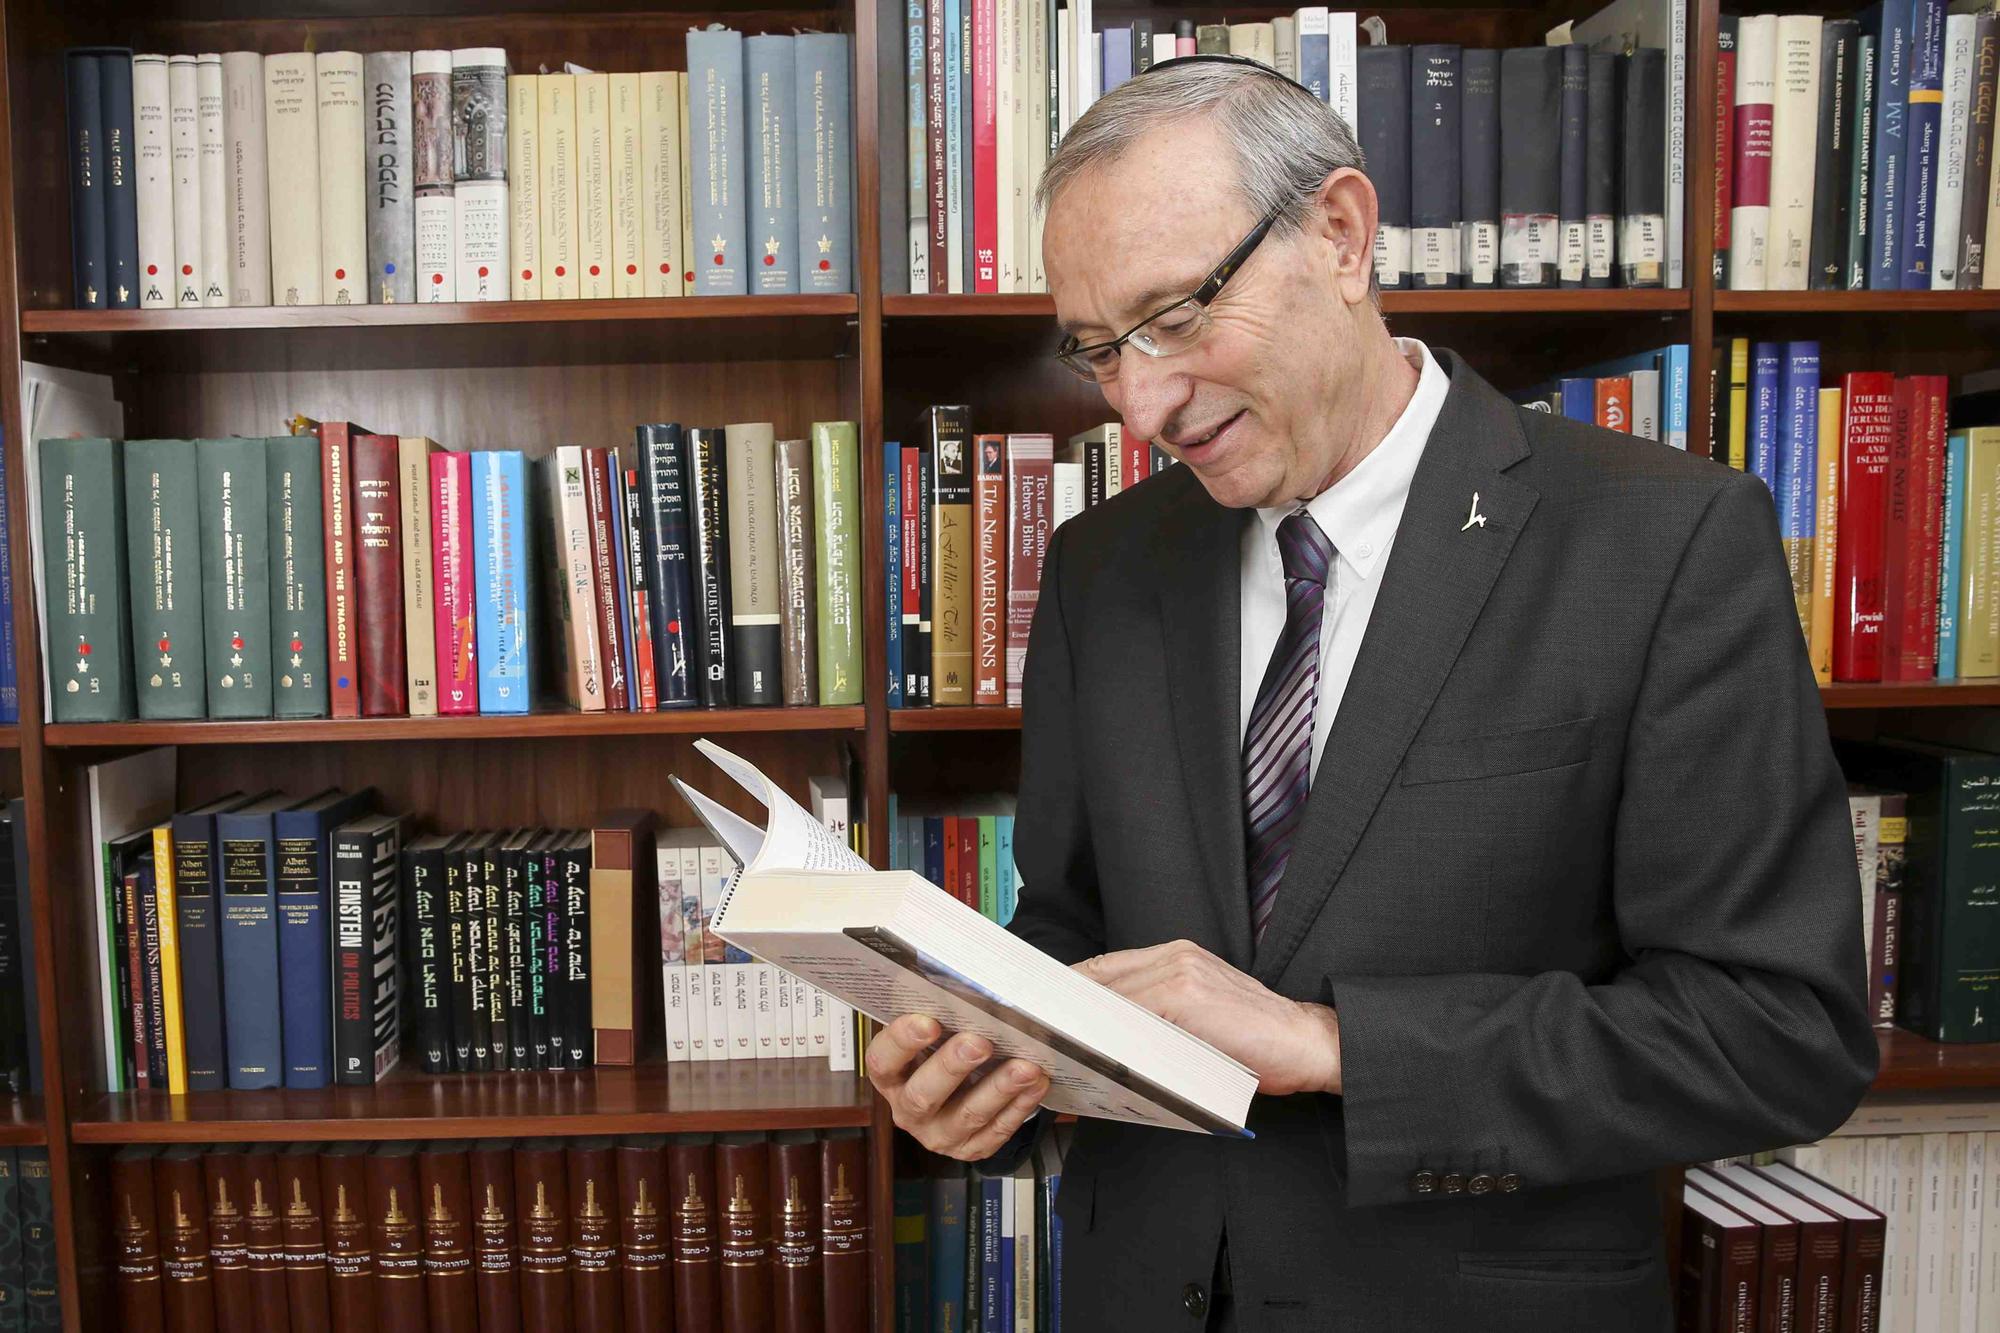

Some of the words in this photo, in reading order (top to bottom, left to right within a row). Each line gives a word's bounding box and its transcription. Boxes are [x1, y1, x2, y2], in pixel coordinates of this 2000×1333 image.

[932, 16, 940, 35] שנים
[910, 25, 923, 75] מספרד
[1837, 38, 1845, 56] THE
[1891, 28, 1902, 76] Catalogue
[1956, 38, 1968, 62] ספר
[1976, 36, 1995, 76] הלכה
[933, 52, 941, 76] ספרים
[1427, 69, 1454, 78] ישראל
[1674, 54, 1683, 81] פירוש
[1864, 48, 1874, 102] KAUFMANN
[1950, 66, 1966, 92] עולי
[1972, 82, 1992, 124] וקבלה
[1833, 99, 1842, 150] CIVILIZATION
[1860, 107, 1872, 170] CHRISTIANITY
[1920, 122, 1932, 154] Europe
[1670, 127, 1682, 160] למסכת
[1948, 100, 1964, 188] הסרטיפיקאטים
[660, 134, 669, 217] MEDITERRANEAN
[1672, 163, 1682, 184] שבת
[1920, 156, 1928, 164] in
[378, 154, 399, 209] ספרד
[523, 137, 532, 219] MEDITERRANEAN
[556, 136, 565, 219] MEDITERRANEAN
[592, 136, 601, 218] MEDITERRANEAN
[625, 135, 633, 218] MEDITERRANEAN
[1860, 174, 1868, 194] AND
[1886, 155, 1896, 198] Lithuania
[1916, 167, 1929, 218] Architecture
[936, 200, 944, 208] of
[1858, 197, 1867, 236] JUDAISM
[1886, 201, 1894, 210] in
[662, 220, 670, 260] SOCIETY
[937, 209, 946, 240] Century
[1915, 220, 1926, 248] Jewish
[524, 223, 533, 264] SOCIETY
[558, 222, 566, 262] SOCIETY
[594, 221, 602, 261] SOCIETY
[1882, 214, 1894, 268] Synagogues
[1760, 386, 1771, 410] קטעי
[1794, 386, 1806, 410] קטעי
[1851, 405, 1872, 414] AND
[1854, 395, 1874, 404] THE
[1108, 432, 1118, 453] ורנר
[1851, 425, 1862, 434] IN
[1894, 408, 1908, 460] ZWEIG
[650, 442, 674, 452] צמיחת
[1759, 442, 1770, 474] קאהיר
[1792, 442, 1804, 474] קאהיר
[1866, 446, 1886, 454] AND
[696, 440, 710, 500] ZELMAN
[788, 468, 800, 500] חכמי
[1828, 461, 1836, 492] LONG
[1866, 466, 1884, 474] ART
[332, 446, 342, 536] FORTIFICATIONS
[652, 494, 682, 504] האסלאם
[982, 485, 998, 514] The
[1022, 474, 1034, 521] Hebrew
[1036, 474, 1048, 501] Text
[790, 505, 802, 544] אשכנז
[832, 502, 842, 530] חכמי
[942, 511, 958, 529] A
[1827, 494, 1836, 526] WALK
[572, 528, 585, 551] קהל
[598, 520, 608, 554] ROTHSCHILD
[700, 507, 713, 564] COWEN
[832, 534, 843, 566] צרפת
[982, 519, 997, 553] New
[1022, 525, 1034, 557] Bible
[1036, 519, 1048, 558] Canon
[1826, 530, 1834, 544] TO
[334, 540, 344, 564] AND
[442, 556, 450, 579] מדינת
[600, 555, 608, 566] AND
[939, 532, 959, 600] Fiddler's
[336, 569, 344, 590] THE
[574, 559, 588, 594] ישראל
[602, 567, 610, 584] EARLY
[749, 569, 758, 606] הירושלמי
[792, 548, 805, 608] הראשונים
[1824, 548, 1834, 598] FREEDOM
[443, 582, 452, 606] ישראל
[604, 585, 612, 606] JEWISH
[708, 583, 720, 626] PUBLIC
[832, 570, 844, 624] הראשונים
[944, 606, 959, 643] Tale
[982, 556, 996, 668] AMERICANS
[1856, 612, 1884, 624] Jewish
[336, 595, 346, 662] SYNAGOGUE
[710, 630, 720, 655] LIFE
[1862, 624, 1878, 634] Art
[233, 858, 256, 866] Albert
[416, 890, 434, 919] עגנון
[449, 890, 464, 913] עגנון
[468, 886, 483, 912] עגנון
[486, 884, 500, 908] עגנון
[508, 890, 523, 916] עגנון
[529, 884, 543, 908] עגנון
[545, 880, 559, 904] עגנון
[566, 886, 585, 916] עגנון
[338, 880, 362, 948] EINSTEIN
[1886, 898, 1896, 922] בימי
[420, 926, 434, 958] אתם
[452, 923, 462, 949] פתחי
[486, 917, 498, 952] בחנותו
[504, 922, 520, 954] לפנים
[530, 921, 545, 956] תכריך
[1884, 926, 1894, 966] הביניים
[126, 886, 134, 924] EINSTEIN
[134, 1003, 144, 1044] Relativity
[342, 952, 359, 968] ON
[452, 952, 464, 982] דברים
[488, 956, 500, 972] של
[510, 955, 524, 968] מן
[567, 952, 586, 981] שוקן
[150, 966, 162, 1026] MIRACULOUS
[343, 972, 360, 1020] POLITICS
[422, 964, 438, 1008] ראיתם
[532, 975, 544, 1015] סיפורים
[490, 992, 504, 1022] לובלין
[154, 1026, 164, 1049] YEAR
[968, 1247, 977, 1284] Citizenship
[1738, 1281, 1747, 1324] CHINESE
[1782, 1278, 1791, 1320] CHINESE
[1819, 1275, 1828, 1317] CHINESE
[1863, 1274, 1872, 1316] CHINESE
